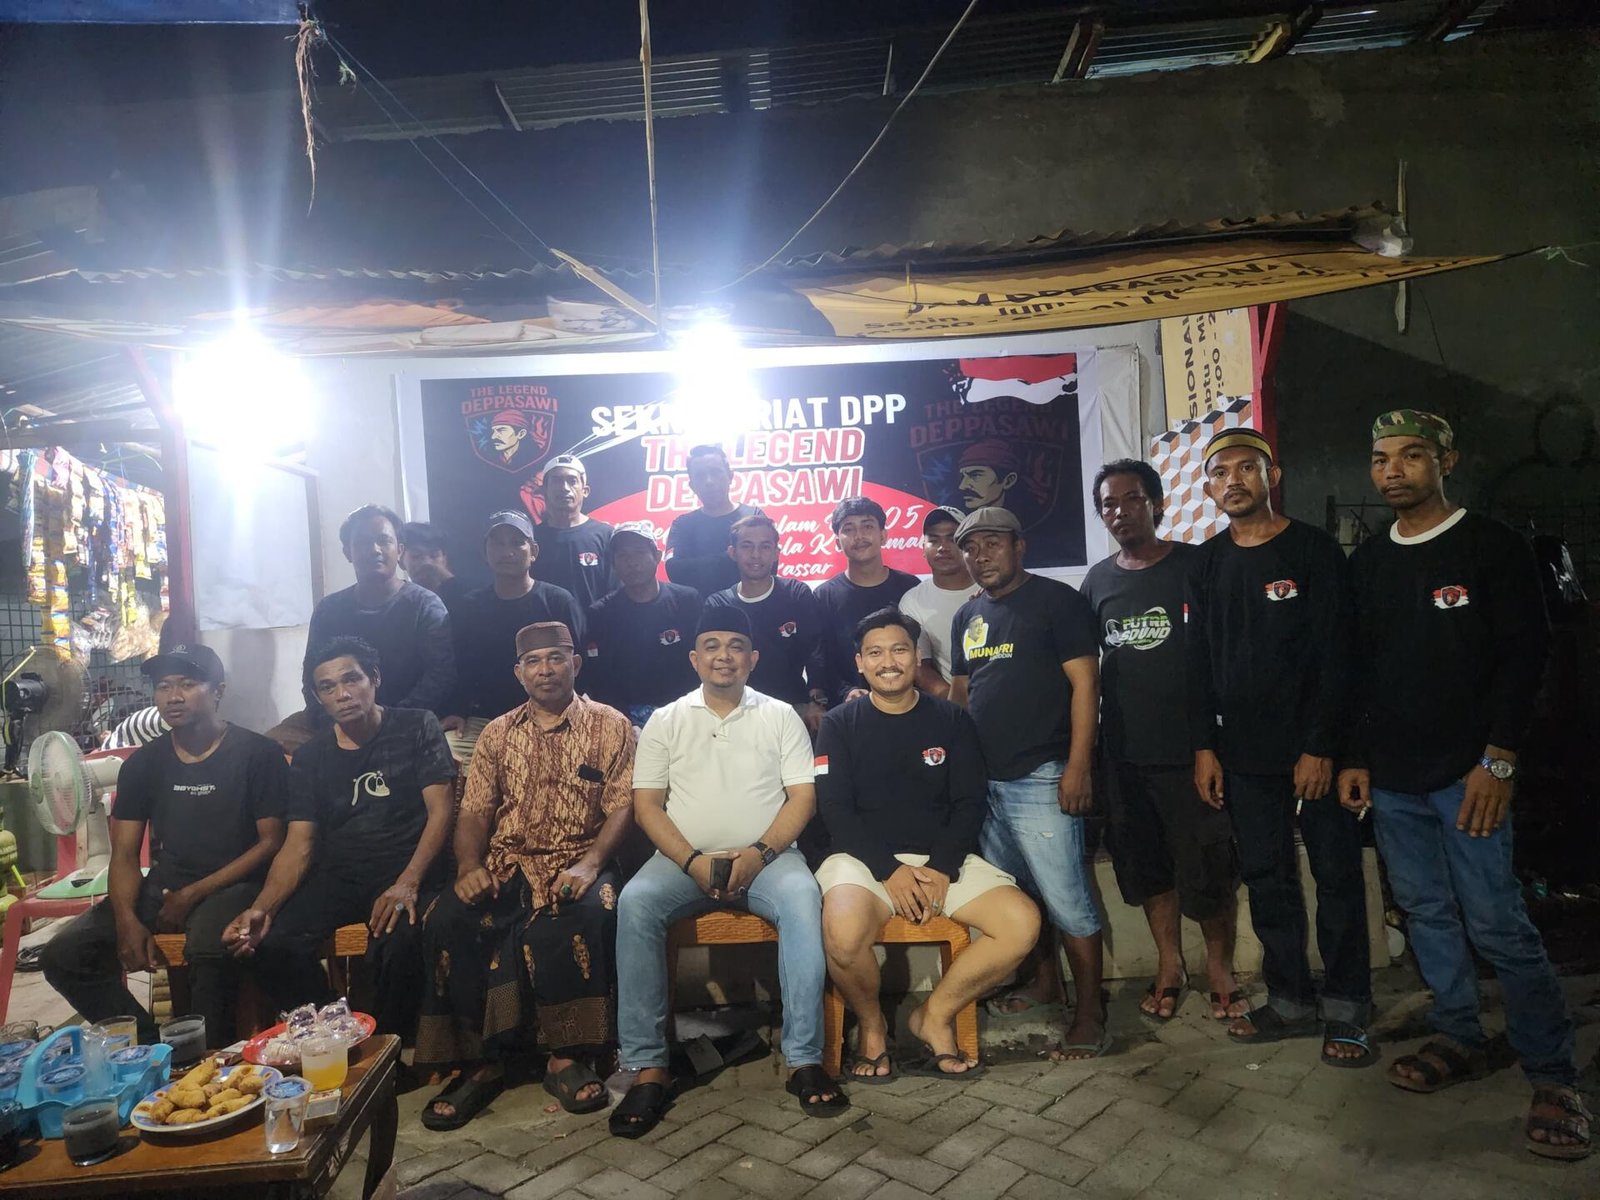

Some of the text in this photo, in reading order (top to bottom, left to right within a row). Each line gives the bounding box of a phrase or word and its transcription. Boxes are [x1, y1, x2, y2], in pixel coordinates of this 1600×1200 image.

[470, 384, 548, 398] THE LEGEND
[461, 395, 558, 414] DEPPASAWI
[840, 394, 907, 426] DPP
[924, 399, 964, 419] THE
[908, 412, 1070, 449] DEPPASAWI
[641, 434, 692, 472] TH
[1122, 615, 1170, 630] PUTRA
[1119, 627, 1171, 641] SOUND
[970, 643, 1014, 660] MUNAFRI
